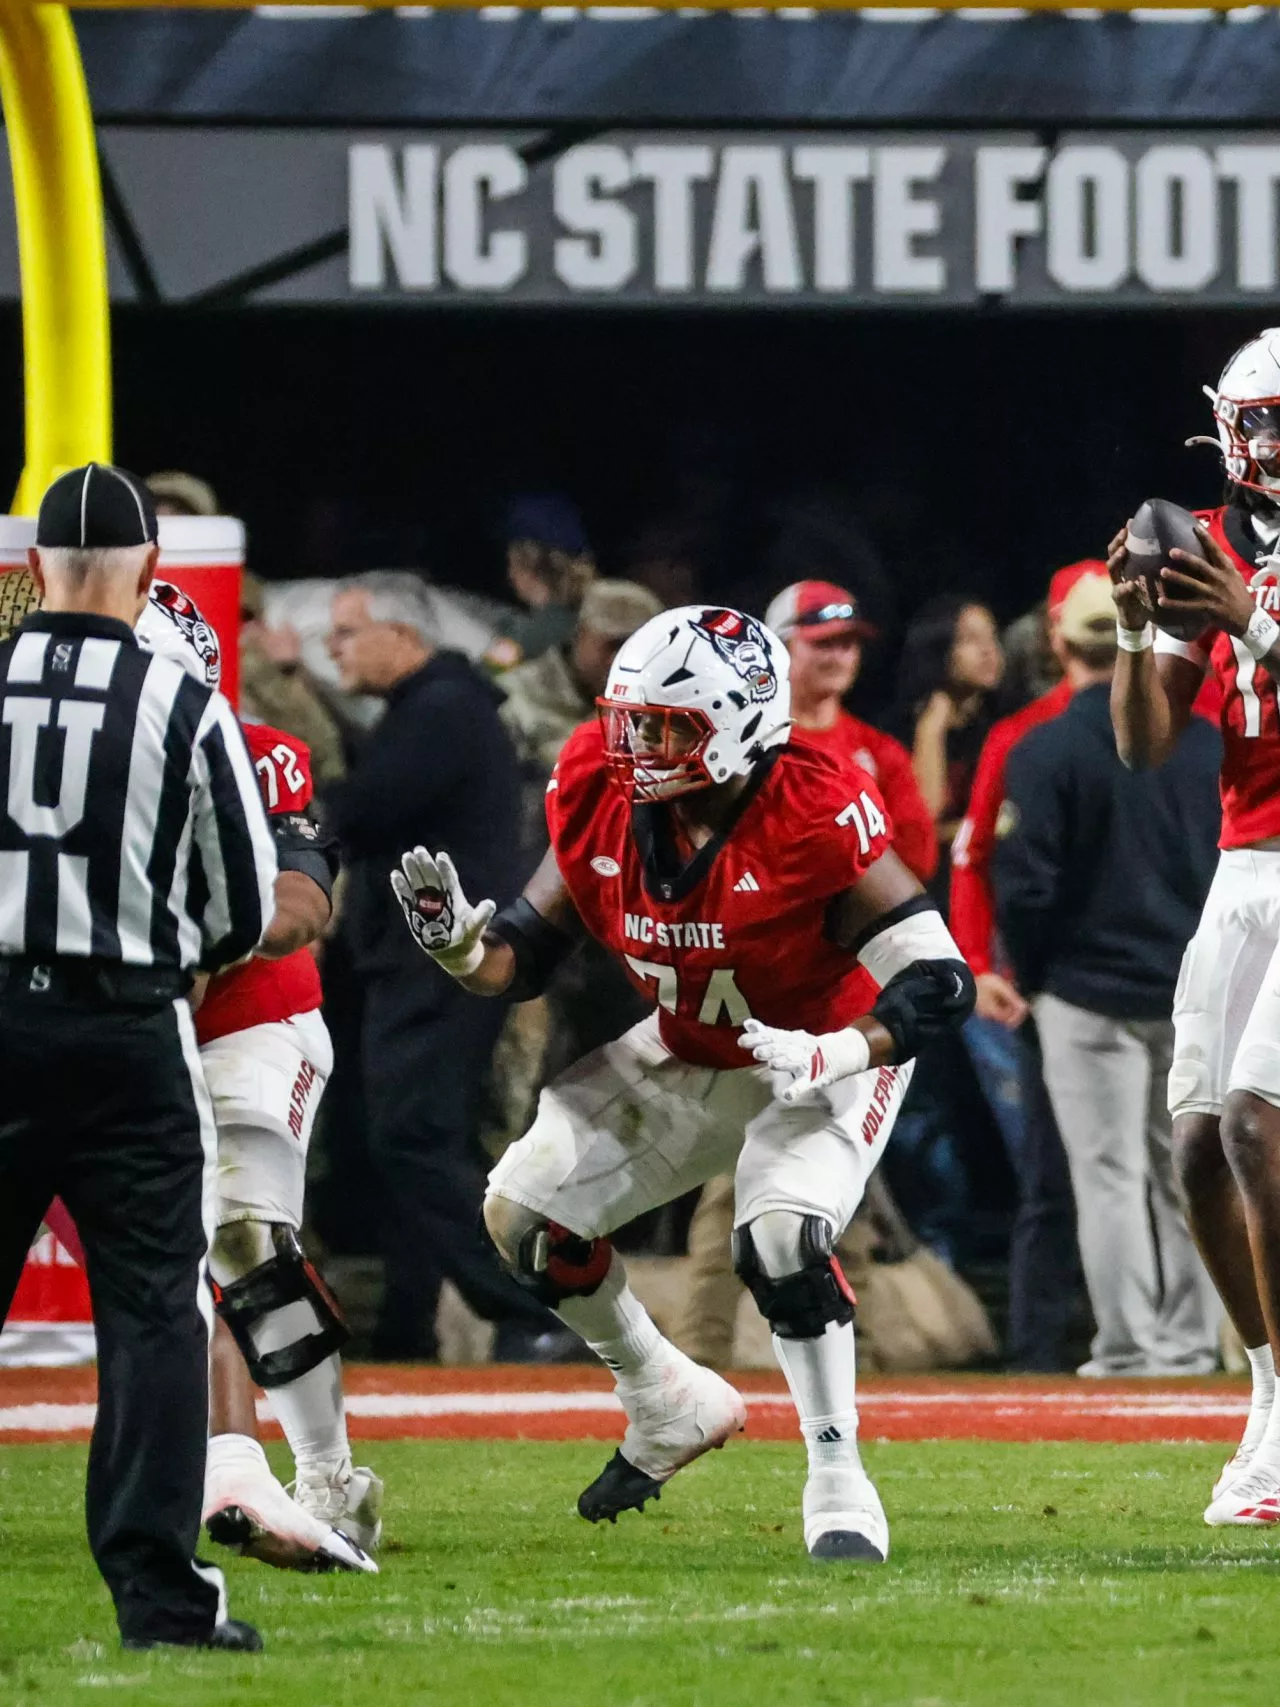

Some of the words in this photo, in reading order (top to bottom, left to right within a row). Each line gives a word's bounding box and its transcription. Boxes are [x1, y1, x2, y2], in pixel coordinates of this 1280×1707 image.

[348, 143, 528, 291] NC
[553, 143, 947, 291] STATE
[2, 696, 106, 838] U
[255, 743, 306, 808] 72
[835, 790, 886, 855] 74
[624, 912, 654, 944] NC
[655, 921, 726, 949] STATE
